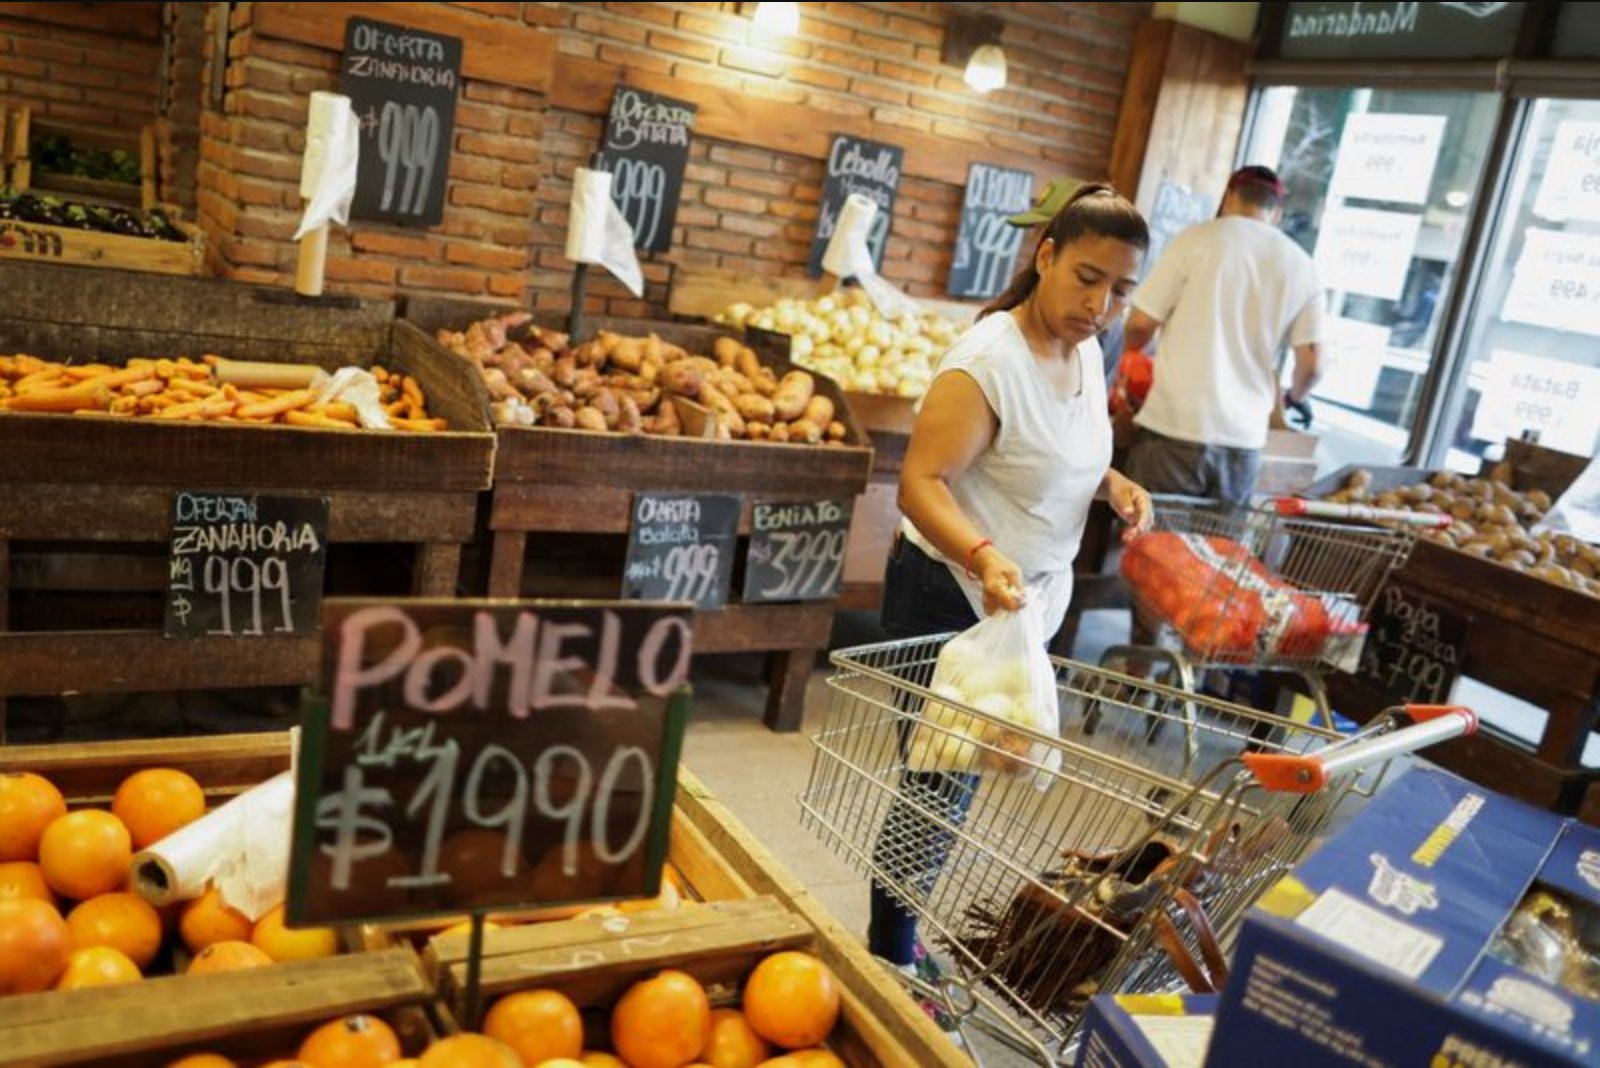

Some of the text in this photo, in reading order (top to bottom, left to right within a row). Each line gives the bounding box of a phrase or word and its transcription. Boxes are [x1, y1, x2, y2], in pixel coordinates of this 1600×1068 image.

[379, 100, 440, 215] 999
[829, 136, 900, 189] Cebolla
[173, 520, 319, 555] ZANAHORIA
[203, 555, 294, 636] 999
